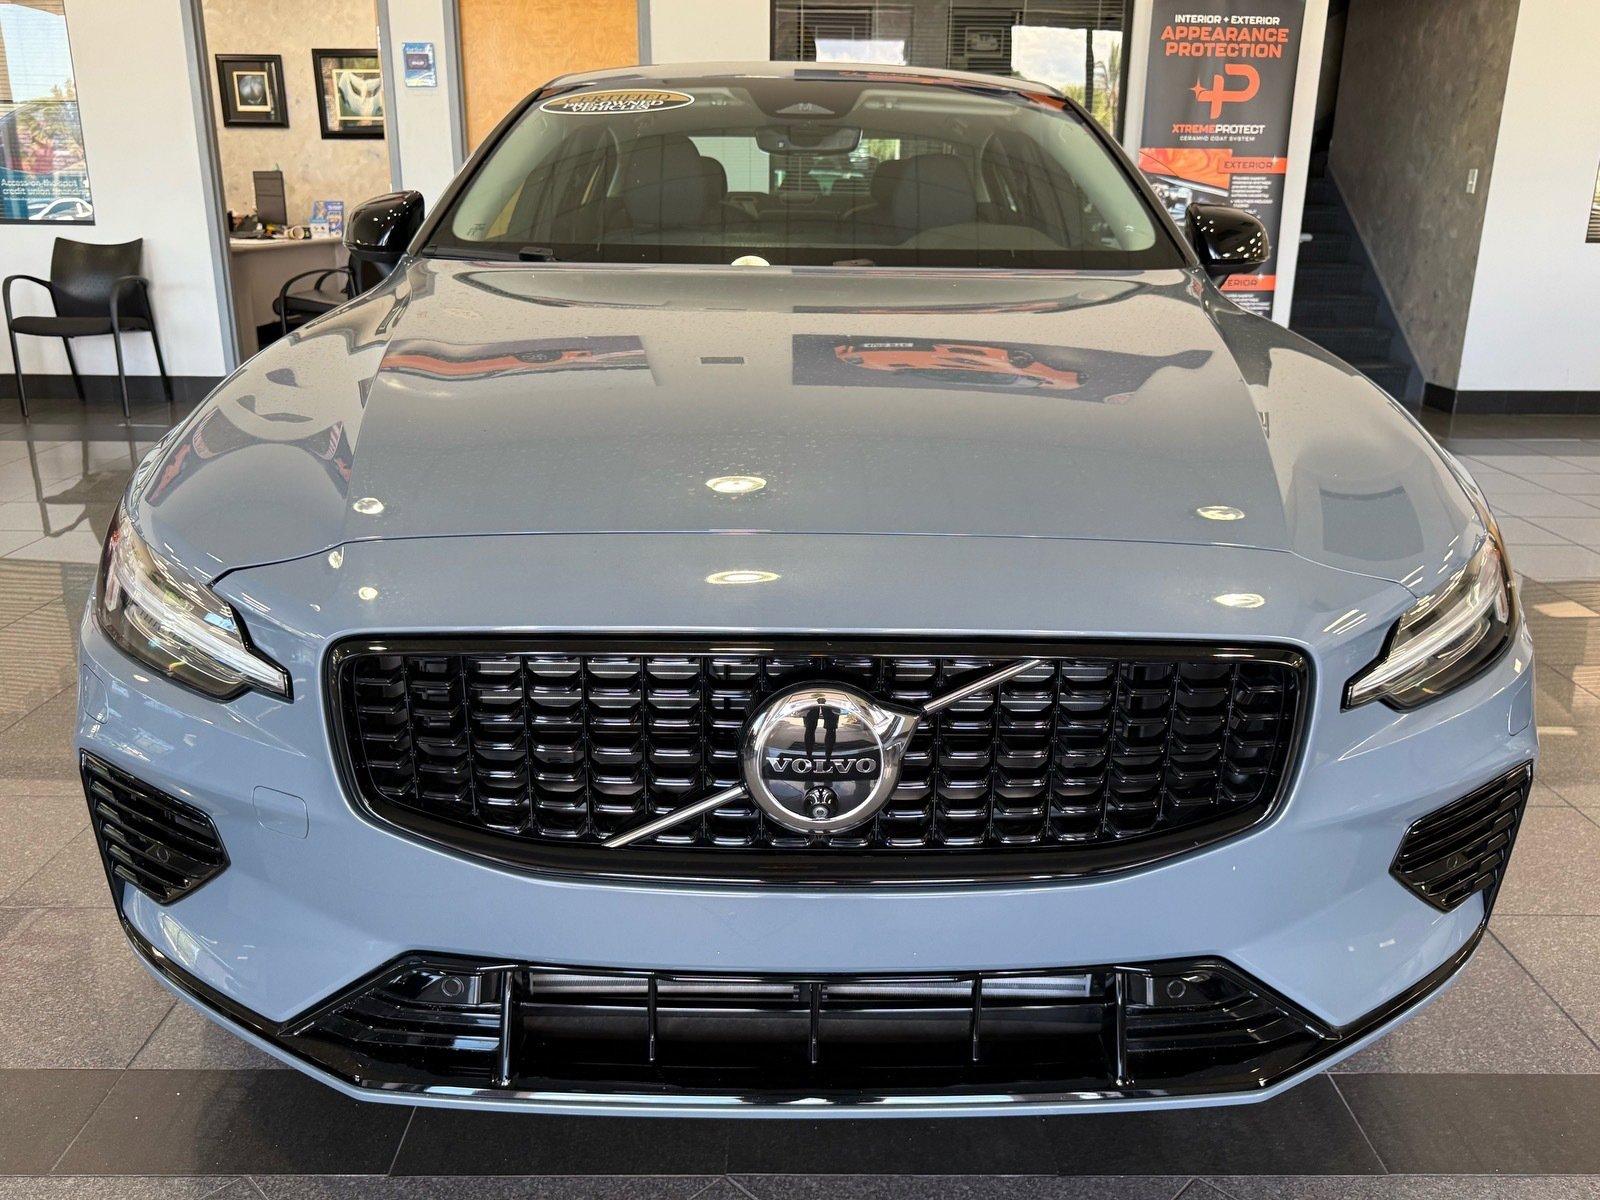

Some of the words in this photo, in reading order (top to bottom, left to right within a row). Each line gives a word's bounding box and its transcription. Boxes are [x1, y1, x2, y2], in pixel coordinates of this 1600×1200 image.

[1175, 14, 1221, 24] INTERIOR
[1230, 16, 1280, 25] EXTERIOR
[1160, 26, 1290, 43] APPEARANCE
[1165, 42, 1282, 58] PROTECTION
[1171, 124, 1266, 134] XTREMEPROTECT
[1223, 161, 1273, 169] EXTERIOR
[1227, 279, 1258, 287] ERIOR
[766, 757, 877, 774] VOLVO
